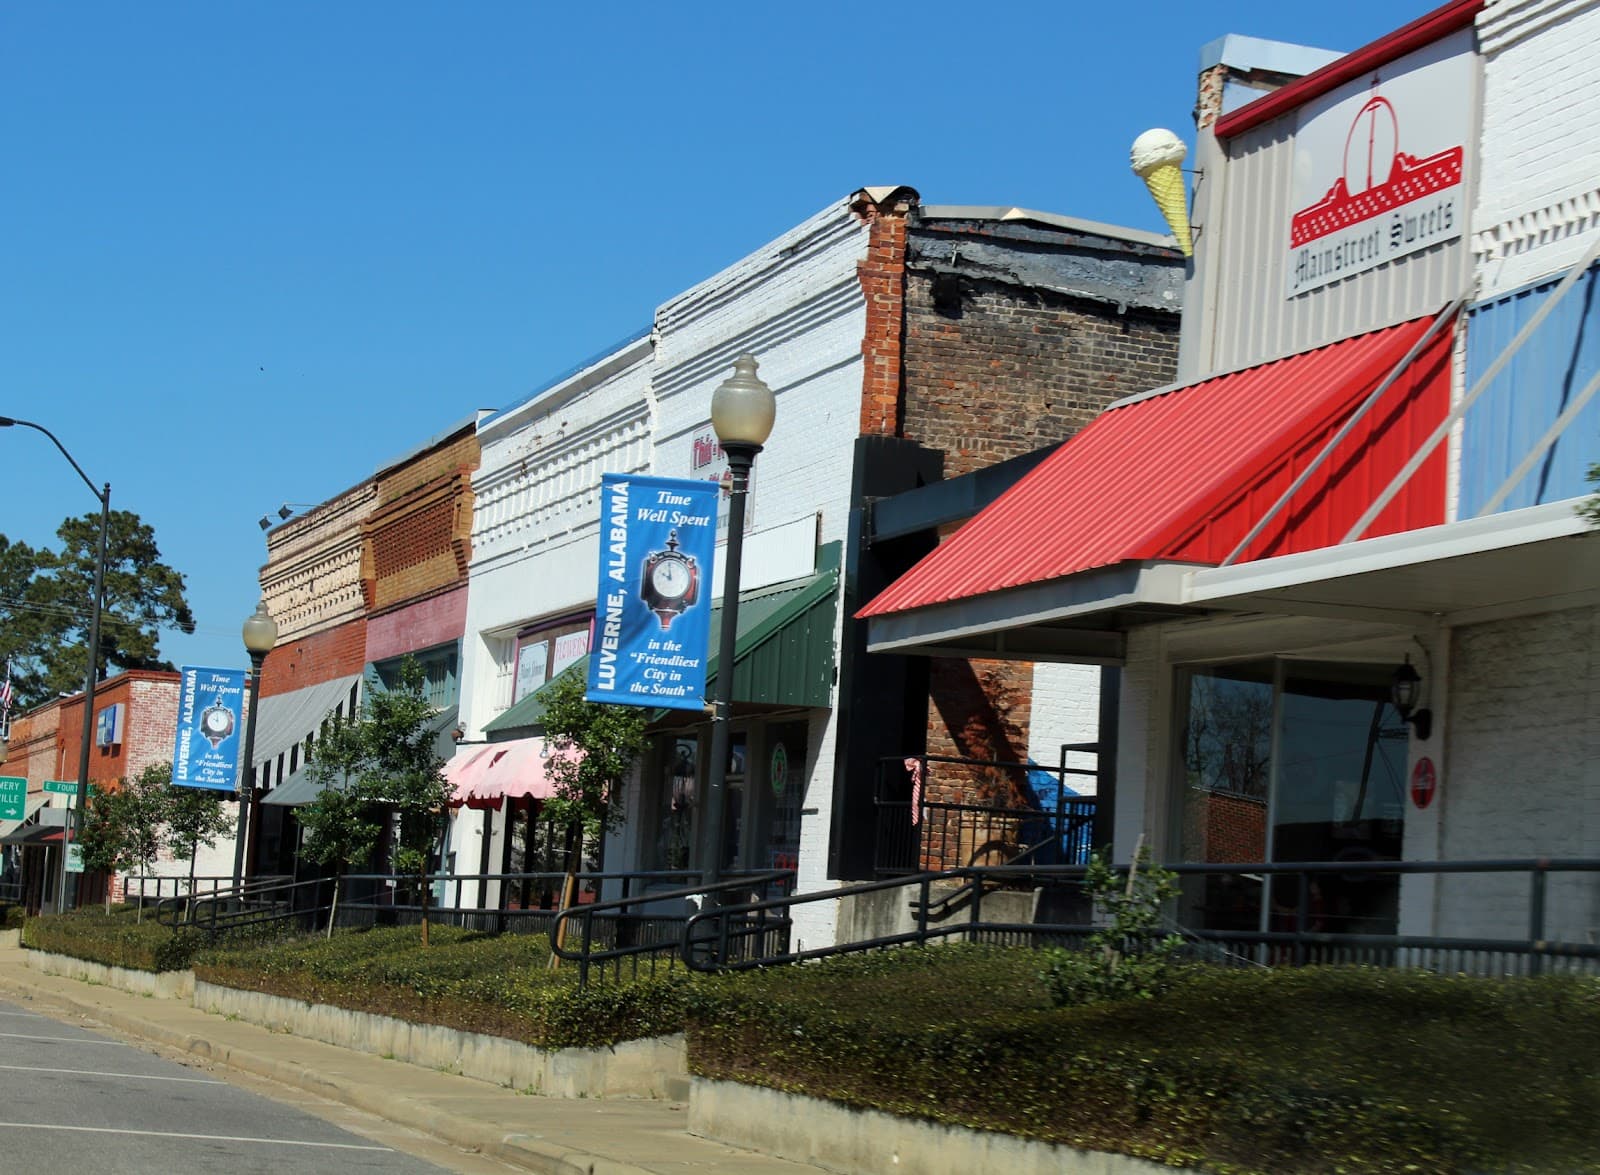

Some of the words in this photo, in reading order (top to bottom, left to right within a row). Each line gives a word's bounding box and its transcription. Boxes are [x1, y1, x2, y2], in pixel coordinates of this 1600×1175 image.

[1294, 228, 1381, 289] Mainstreet
[1390, 197, 1455, 248] Sweets
[656, 491, 692, 506] Time
[637, 507, 668, 522] Well
[669, 510, 711, 527] Spent
[608, 481, 630, 582] ALABAMA
[597, 588, 628, 690] LUVERNE,
[648, 639, 660, 650] in
[663, 640, 682, 652] the
[630, 652, 700, 668] “Friendliest
[211, 674, 230, 683] Time
[643, 667, 667, 682] City
[669, 669, 682, 681] in
[200, 683, 216, 692] Well
[217, 685, 240, 694] Spent
[630, 682, 648, 693] the
[651, 683, 694, 696] South”
[183, 669, 197, 724] ALABAMA
[177, 726, 193, 780] LUVERNE,
[213, 752, 224, 760] the
[45, 782, 51, 790] E
[0, 794, 19, 804] ILLE
